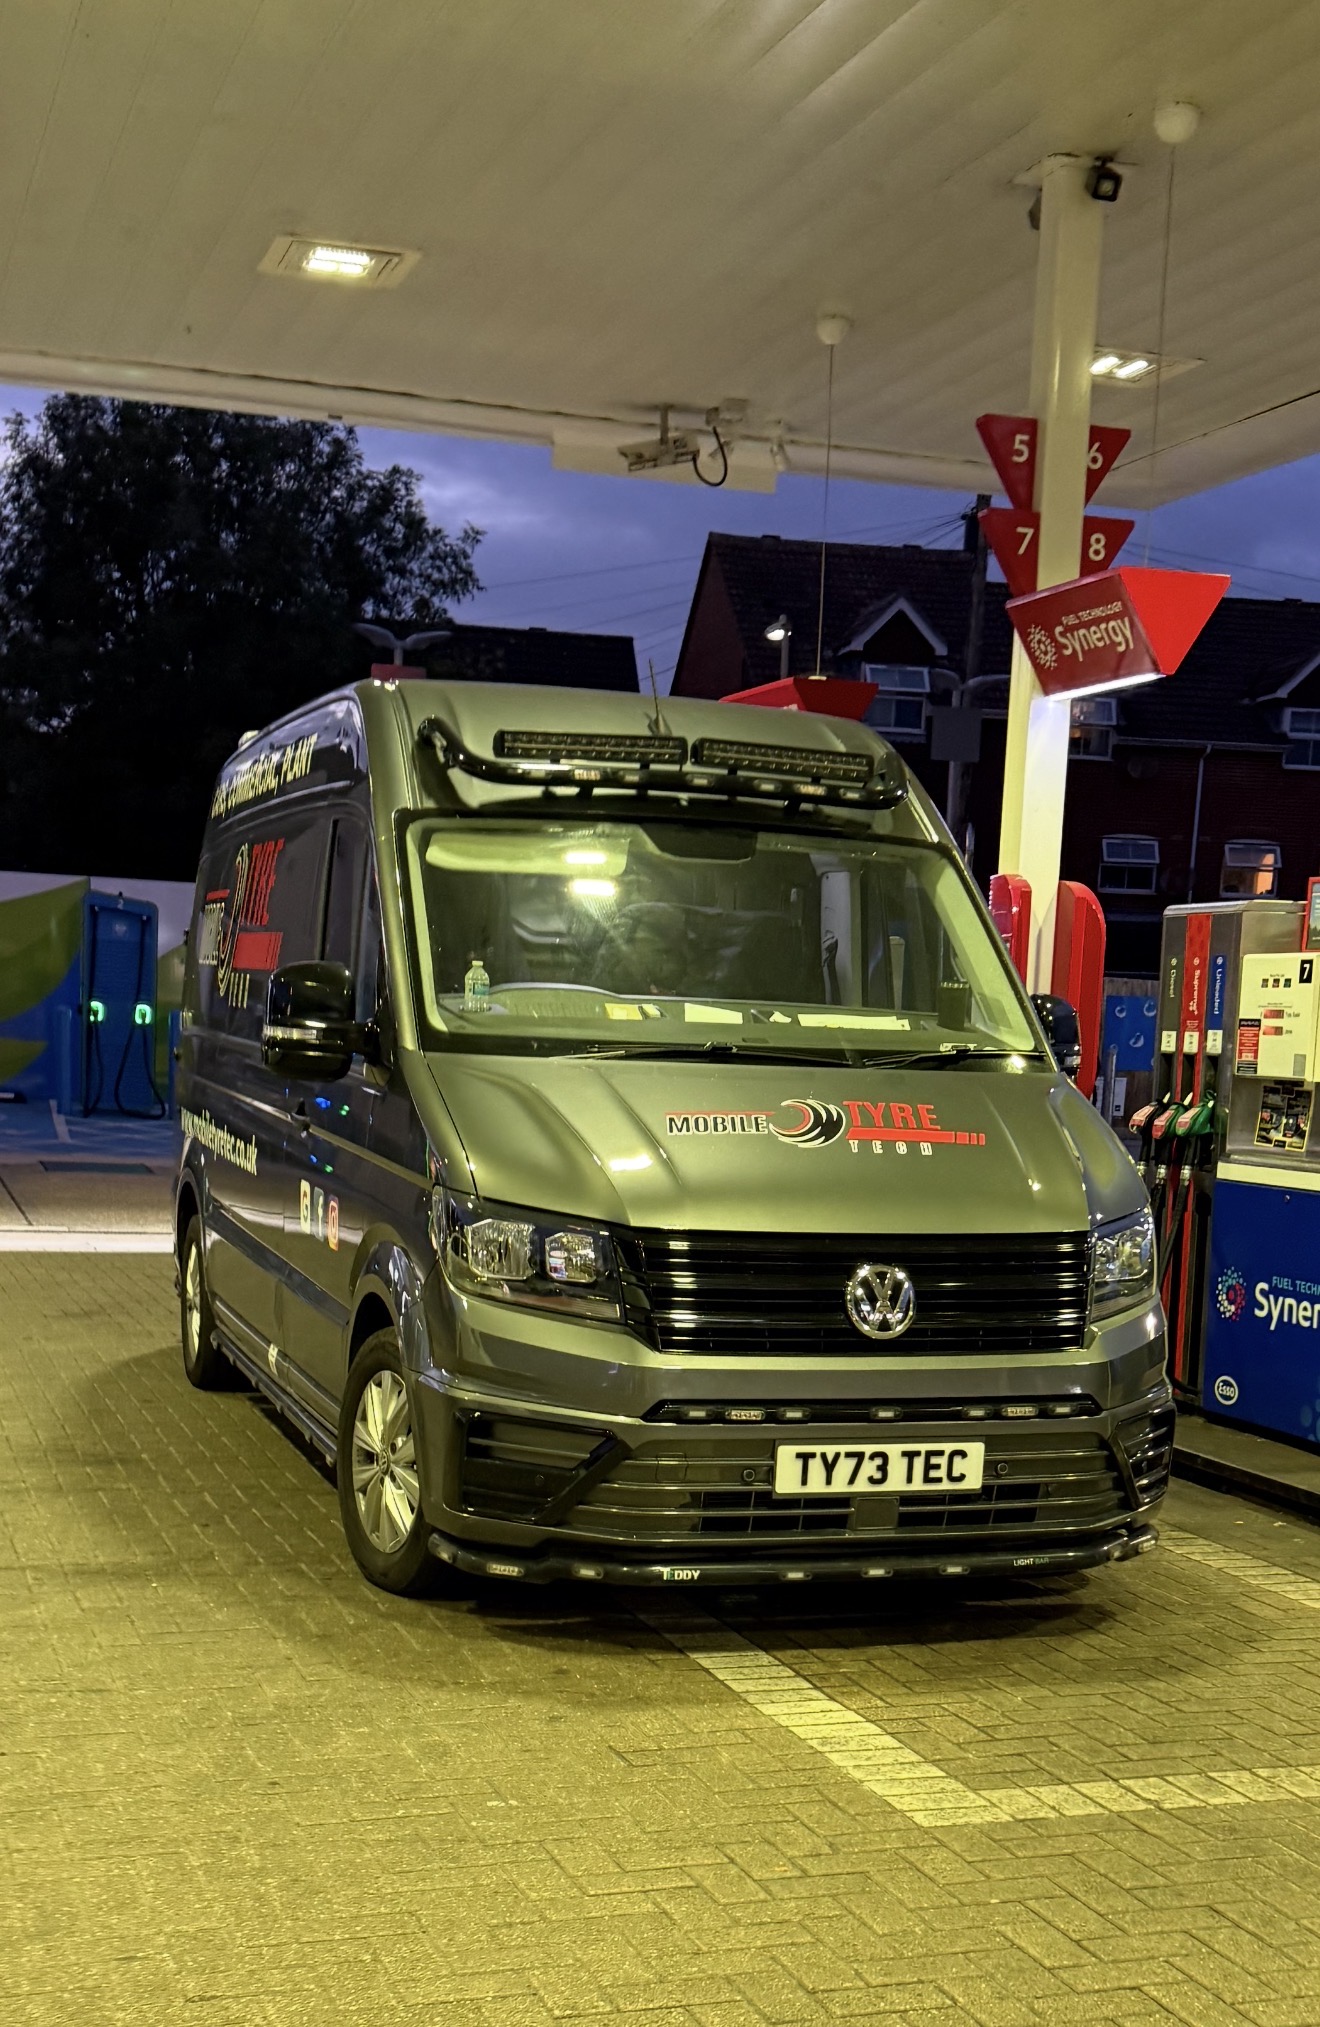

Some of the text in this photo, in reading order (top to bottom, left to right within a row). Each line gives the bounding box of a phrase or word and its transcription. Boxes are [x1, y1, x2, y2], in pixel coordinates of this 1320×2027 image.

[1012, 433, 1030, 463] 5
[1087, 441, 1104, 470] 6
[1016, 526, 1035, 555] 7
[1088, 532, 1107, 561] 8
[1054, 616, 1134, 662] Synergy
[280, 732, 318, 786] PLANT
[1169, 969, 1177, 998] Diesel
[1303, 963, 1311, 980] 7
[1213, 968, 1222, 1015] Unleaded
[666, 1114, 769, 1136] MOBILE
[843, 1101, 941, 1130] TYRE
[1272, 1275, 1294, 1291] FUEL
[1218, 1382, 1235, 1398] Esso
[795, 1448, 968, 1487] TY73 TEC
[1013, 1558, 1034, 1567] LIGHT
